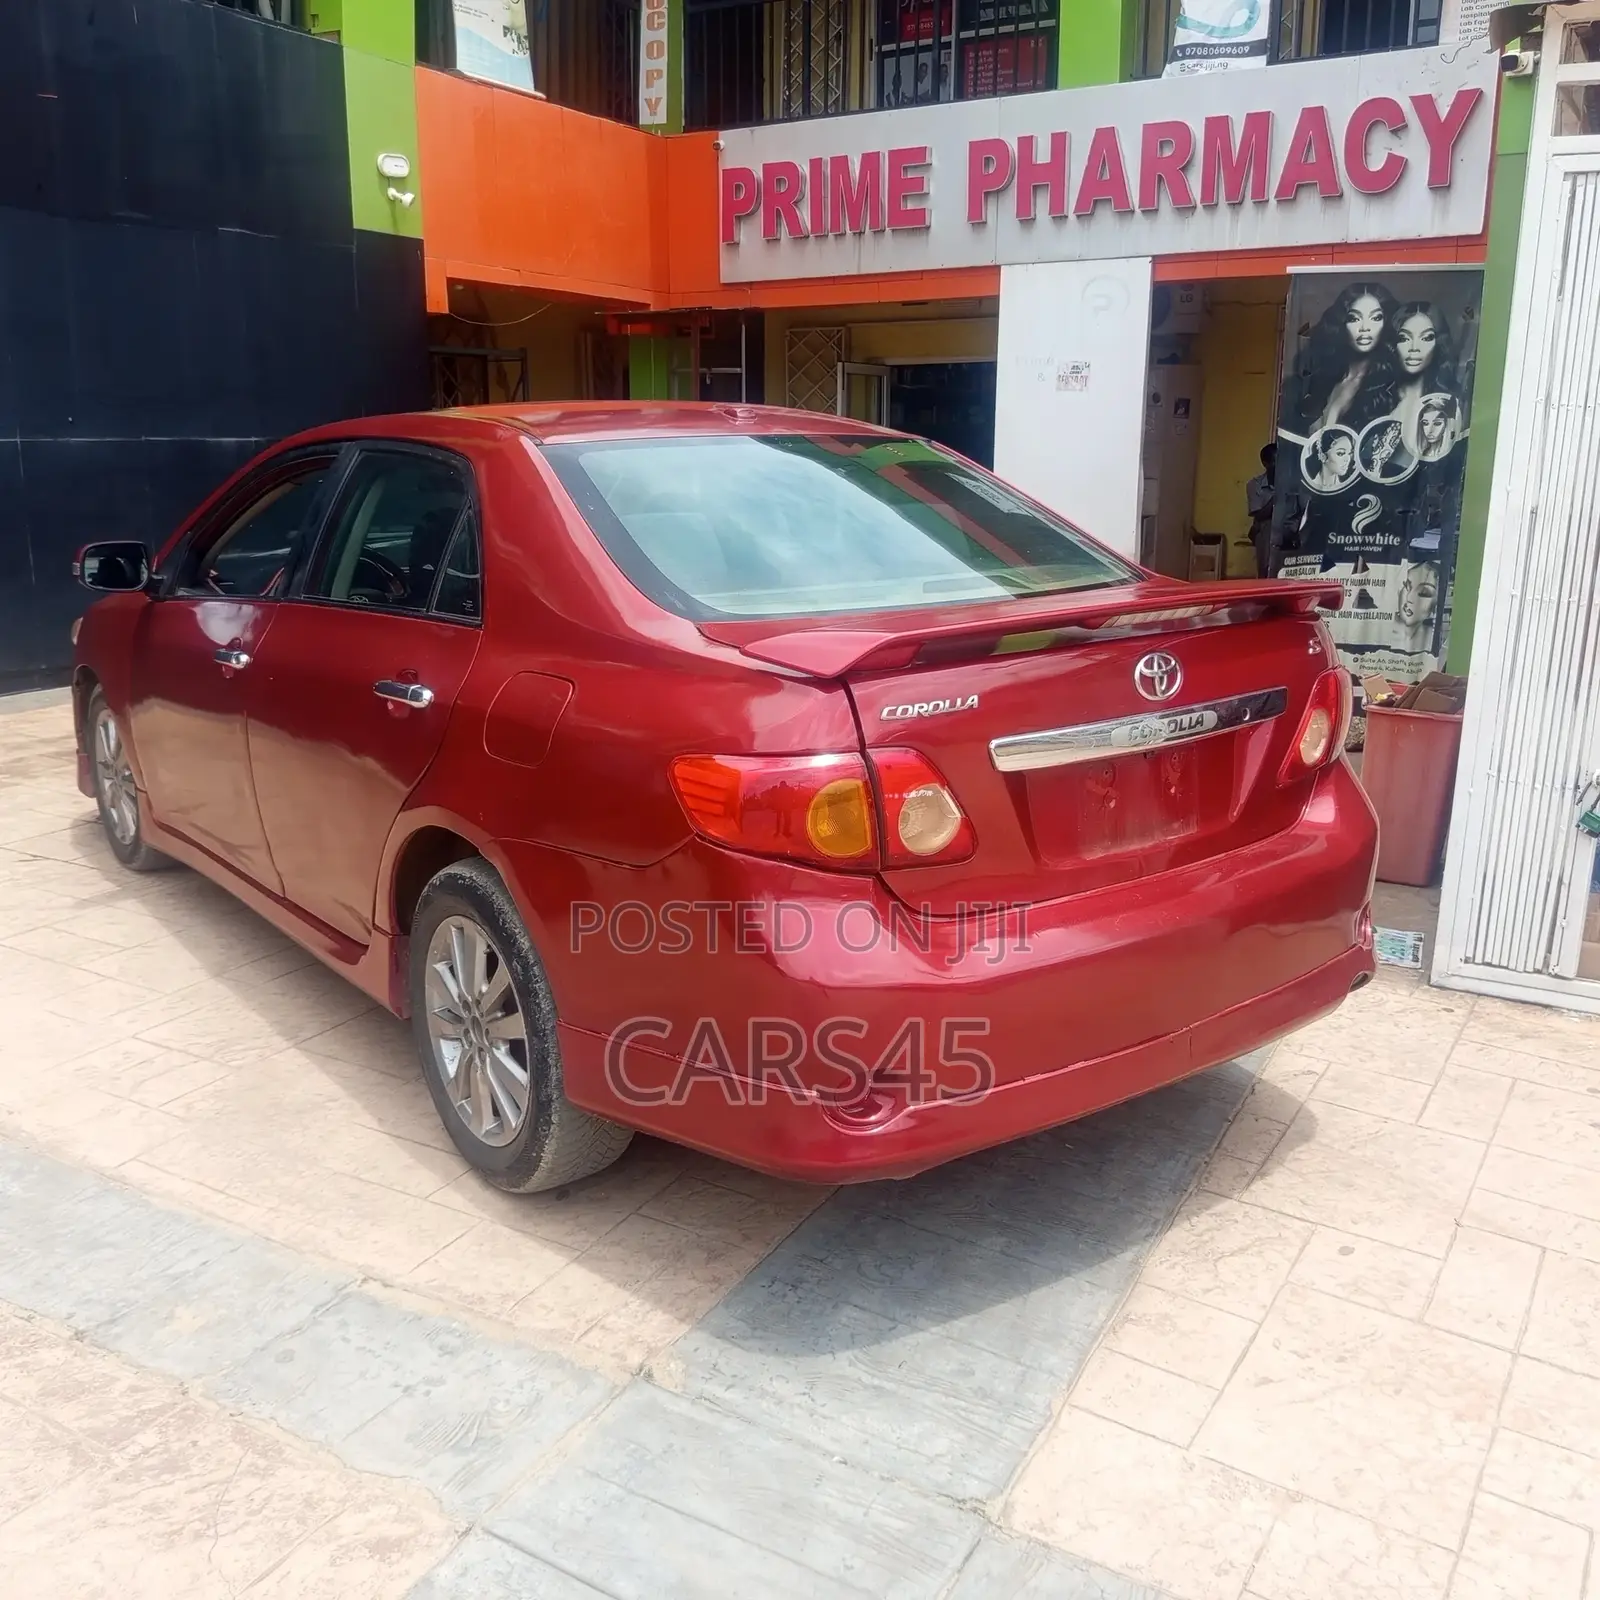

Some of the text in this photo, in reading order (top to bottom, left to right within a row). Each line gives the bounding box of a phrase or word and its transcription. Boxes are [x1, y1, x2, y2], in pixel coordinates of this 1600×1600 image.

[1185, 46, 1250, 56] 07080609609
[721, 88, 1483, 245] PRIME PHARMACY
[1180, 294, 1193, 303] LG
[1327, 532, 1401, 546] Snowwhite
[1284, 554, 1324, 566] OUR SERVICES
[1284, 567, 1316, 577] HAIR SALON
[1350, 578, 1371, 587] HUMAN
[1371, 579, 1387, 587] HAIR
[1338, 610, 1352, 619] HAIR
[1353, 611, 1393, 620] INSTALLATION
[880, 694, 979, 720] COROLLA
